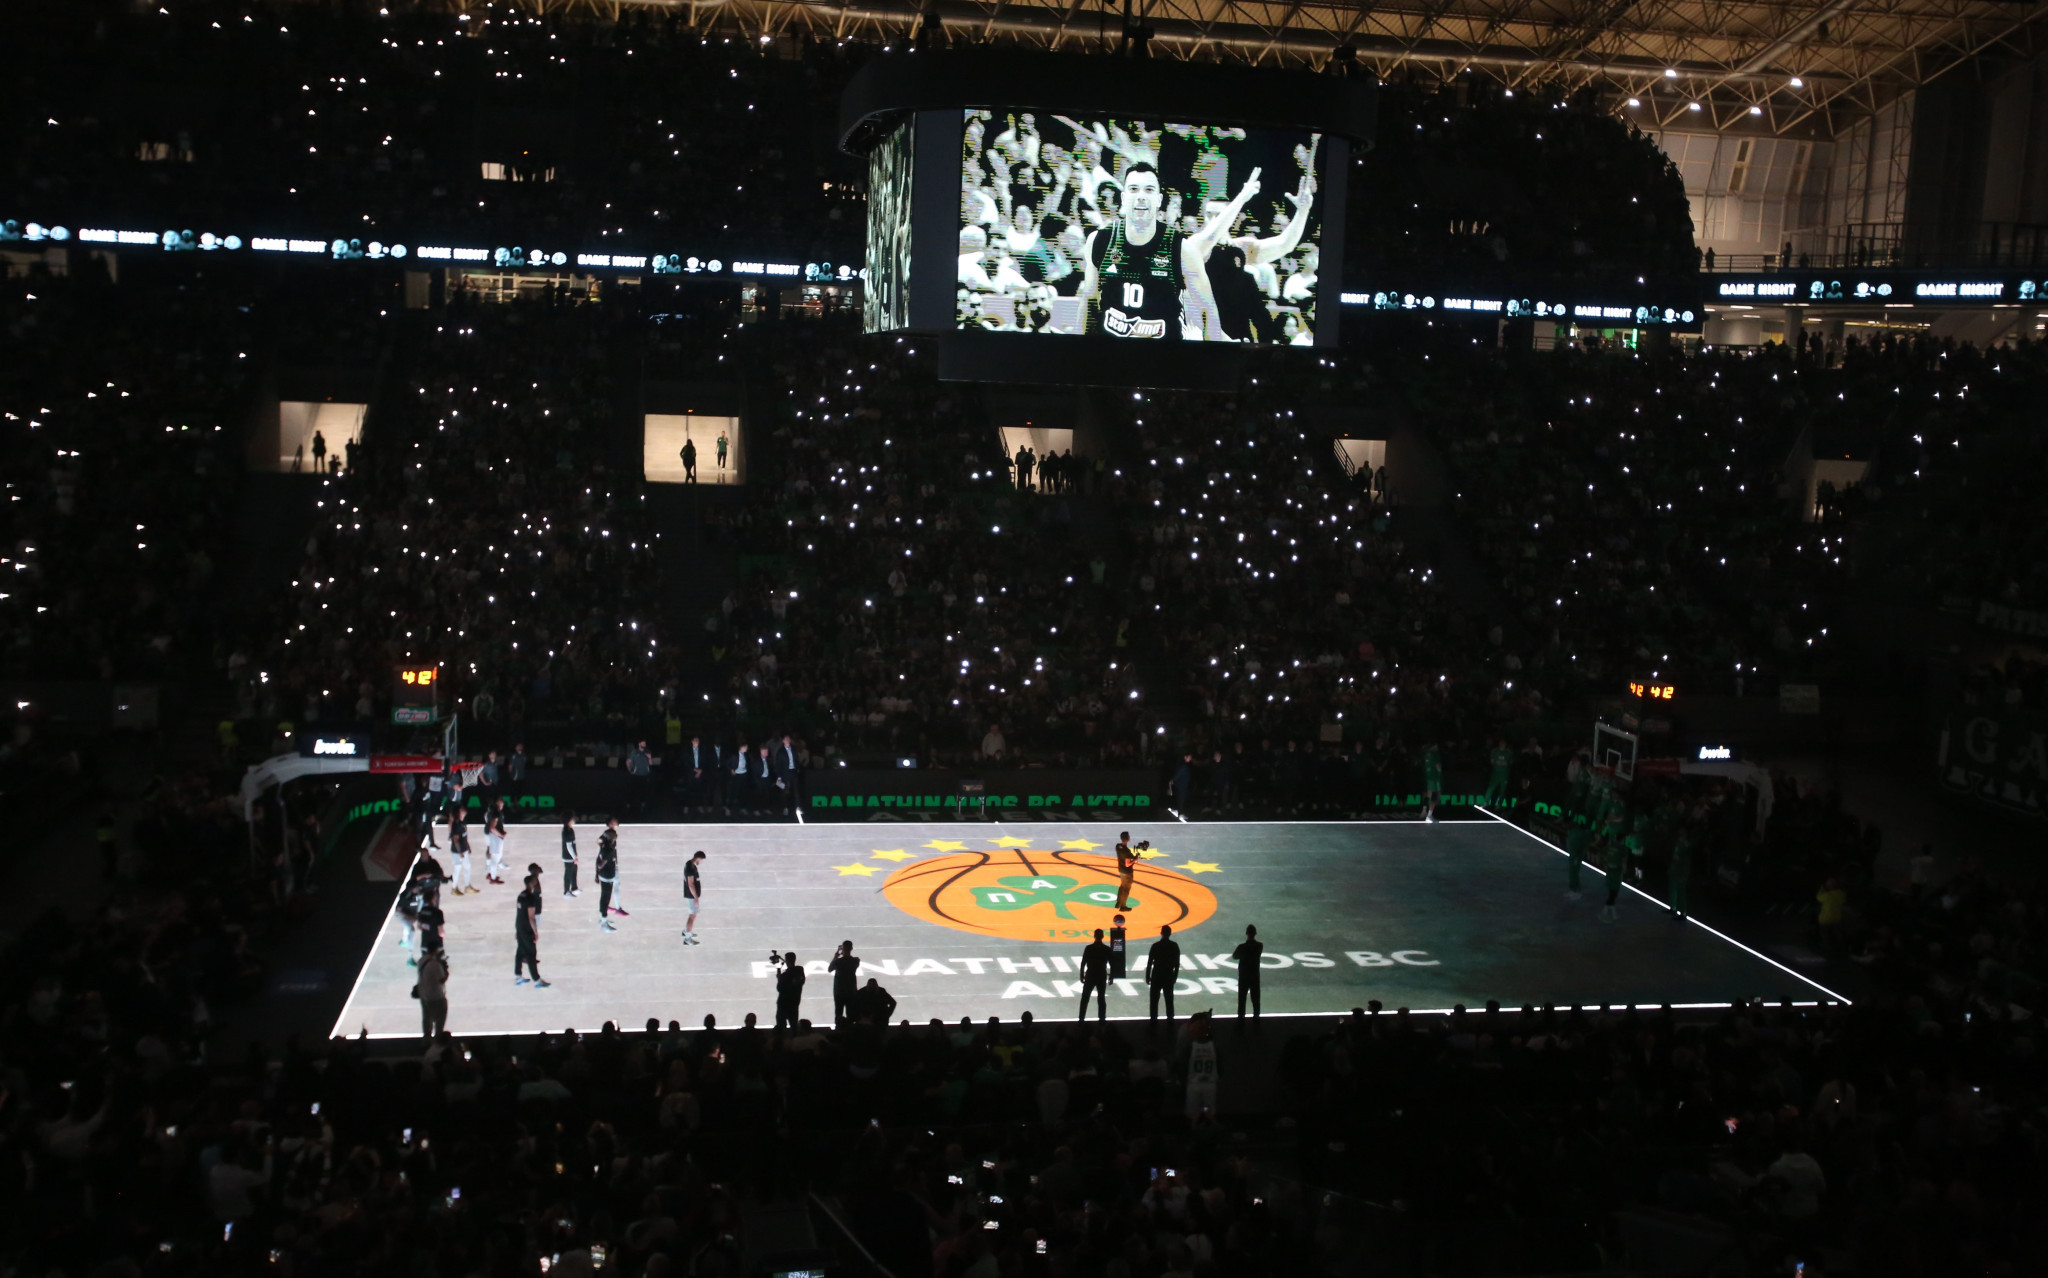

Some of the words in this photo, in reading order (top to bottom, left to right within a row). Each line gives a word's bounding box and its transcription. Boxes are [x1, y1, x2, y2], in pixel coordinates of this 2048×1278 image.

[1123, 282, 1144, 308] 10
[1719, 283, 1756, 295] GAME
[1757, 284, 1797, 296] NIGHT
[1916, 283, 1957, 296] GAME
[1958, 283, 2004, 296] NIGHT
[867, 811, 1124, 822] ATHENS
[1345, 950, 1440, 967] BC
